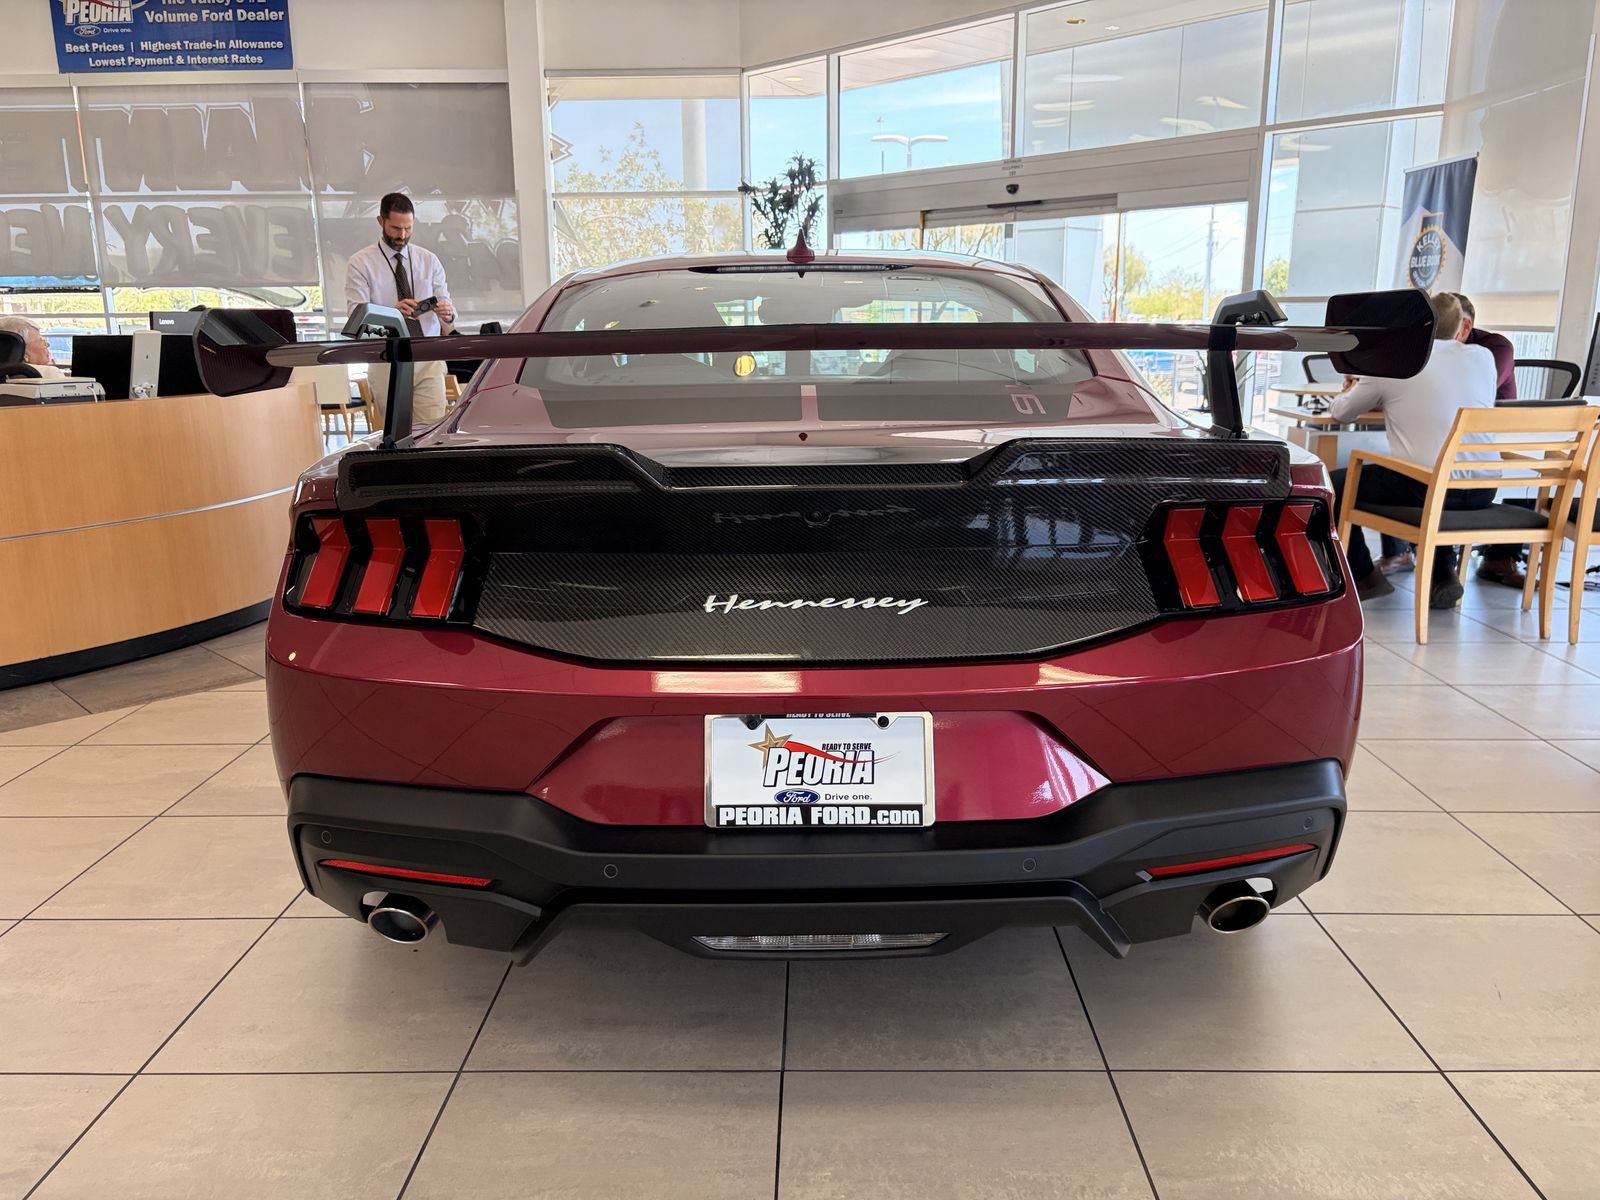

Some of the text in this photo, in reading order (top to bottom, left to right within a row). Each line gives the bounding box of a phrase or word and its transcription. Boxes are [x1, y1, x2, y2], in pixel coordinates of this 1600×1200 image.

[65, 0, 133, 25] PEORIA
[145, 9, 285, 23] Volume Ford Dealer
[65, 40, 283, 53] Best Prices Highest Trade-In Allowance
[89, 54, 264, 67] Lowest Payment & Interest Rates
[1410, 255, 1427, 268] BLUE
[703, 594, 929, 615] Hennessey
[821, 743, 841, 751] READY
[852, 742, 872, 750] SERVE
[763, 746, 875, 787] PEORIA
[824, 793, 873, 801] Drive one.
[719, 806, 920, 826] PEORIA FORD.com
